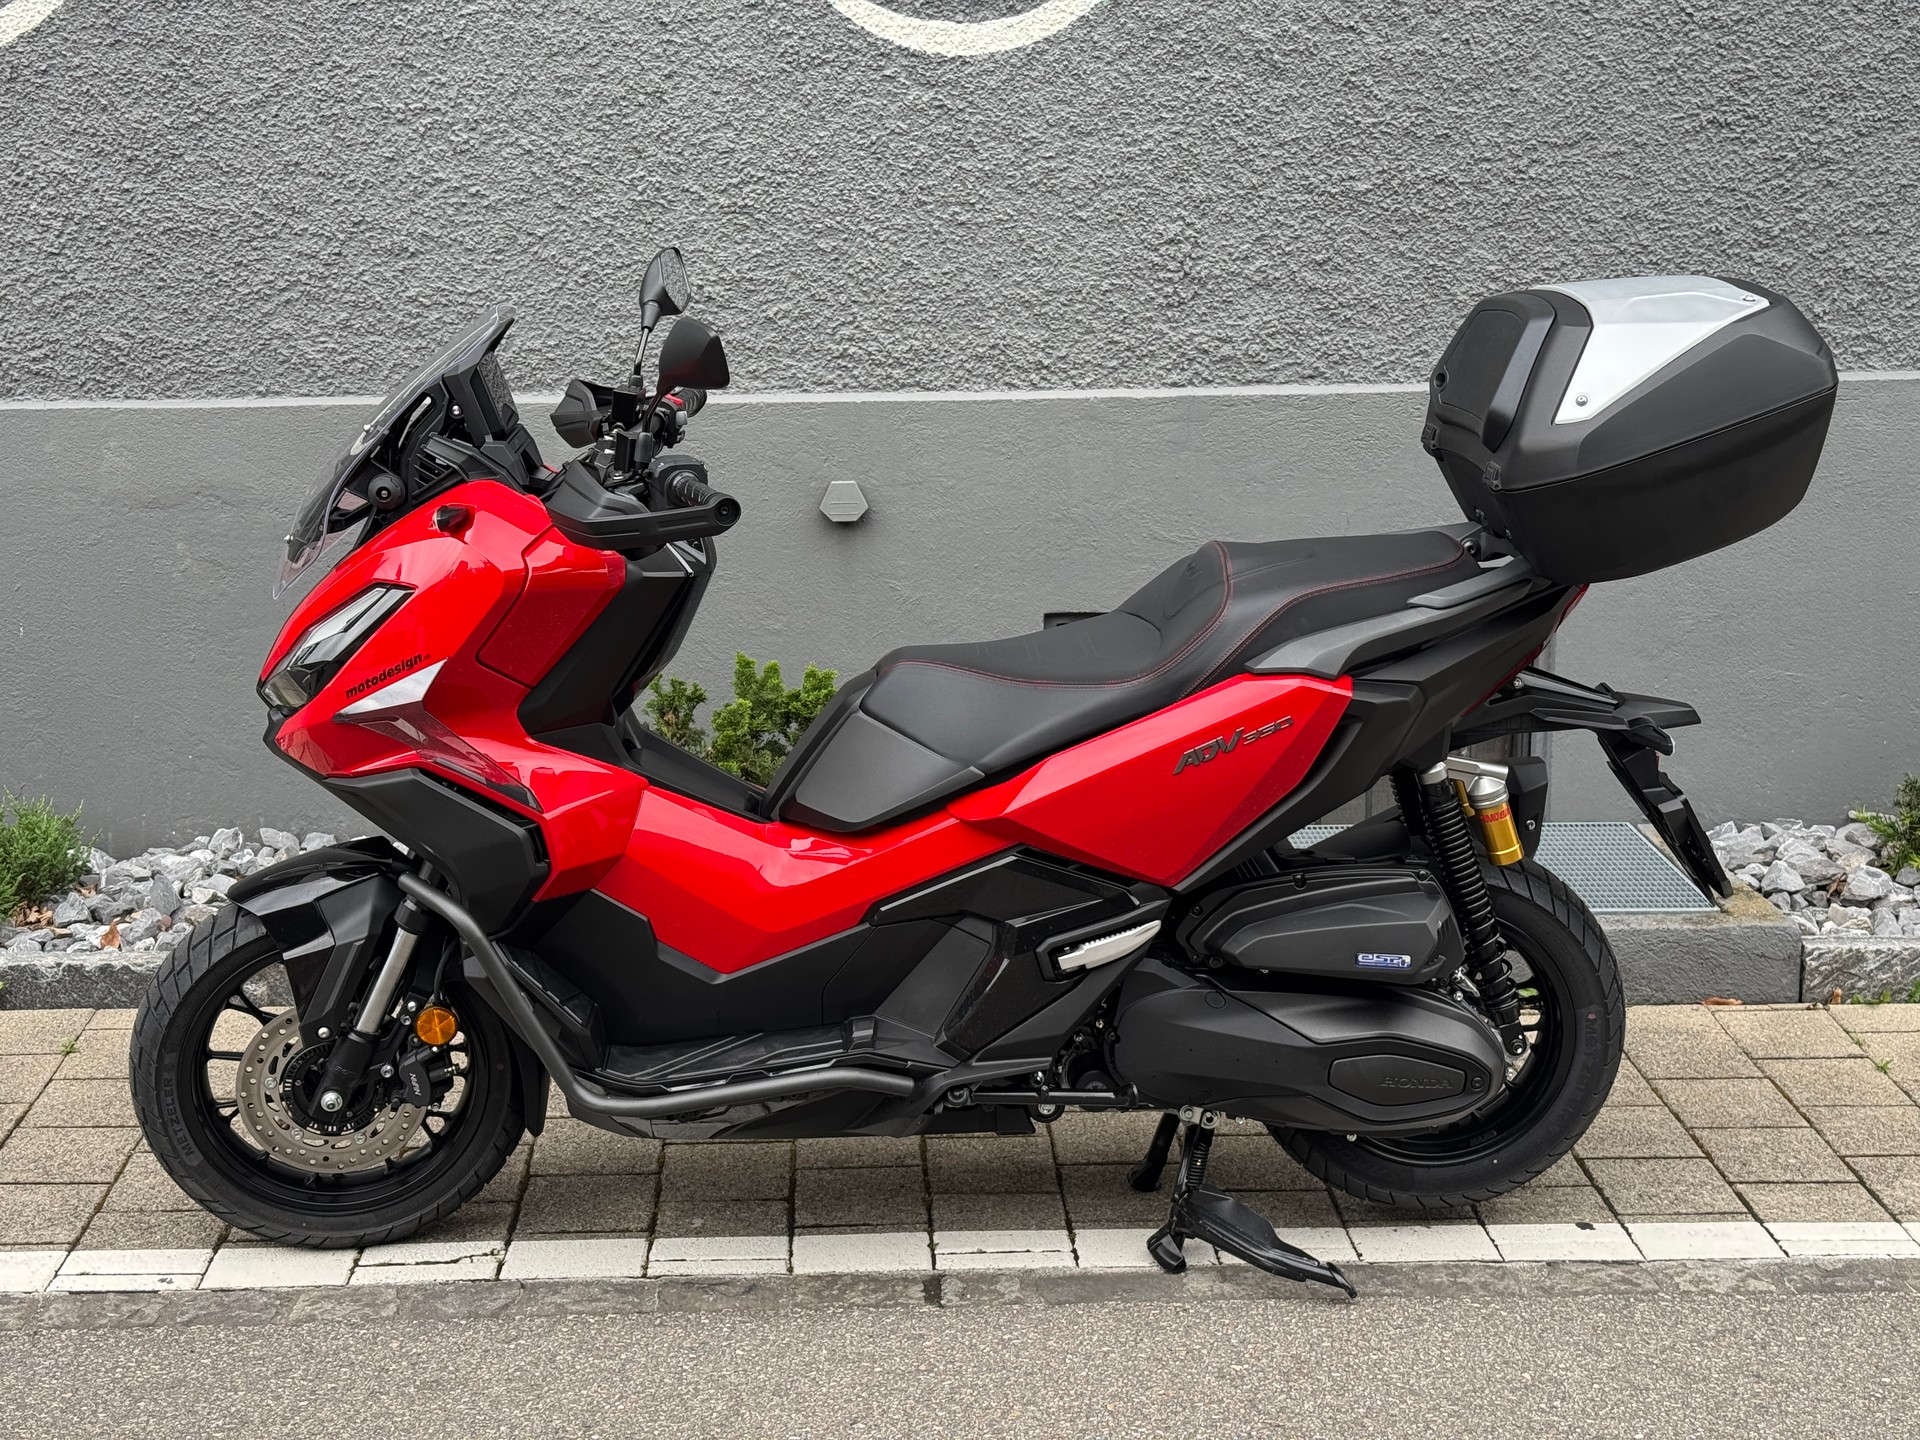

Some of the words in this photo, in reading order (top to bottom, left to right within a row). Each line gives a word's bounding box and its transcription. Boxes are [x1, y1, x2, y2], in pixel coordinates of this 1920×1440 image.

[345, 654, 423, 699] motodesign
[1380, 1077, 1454, 1089] HONDA
[163, 1077, 195, 1157] METZELER
